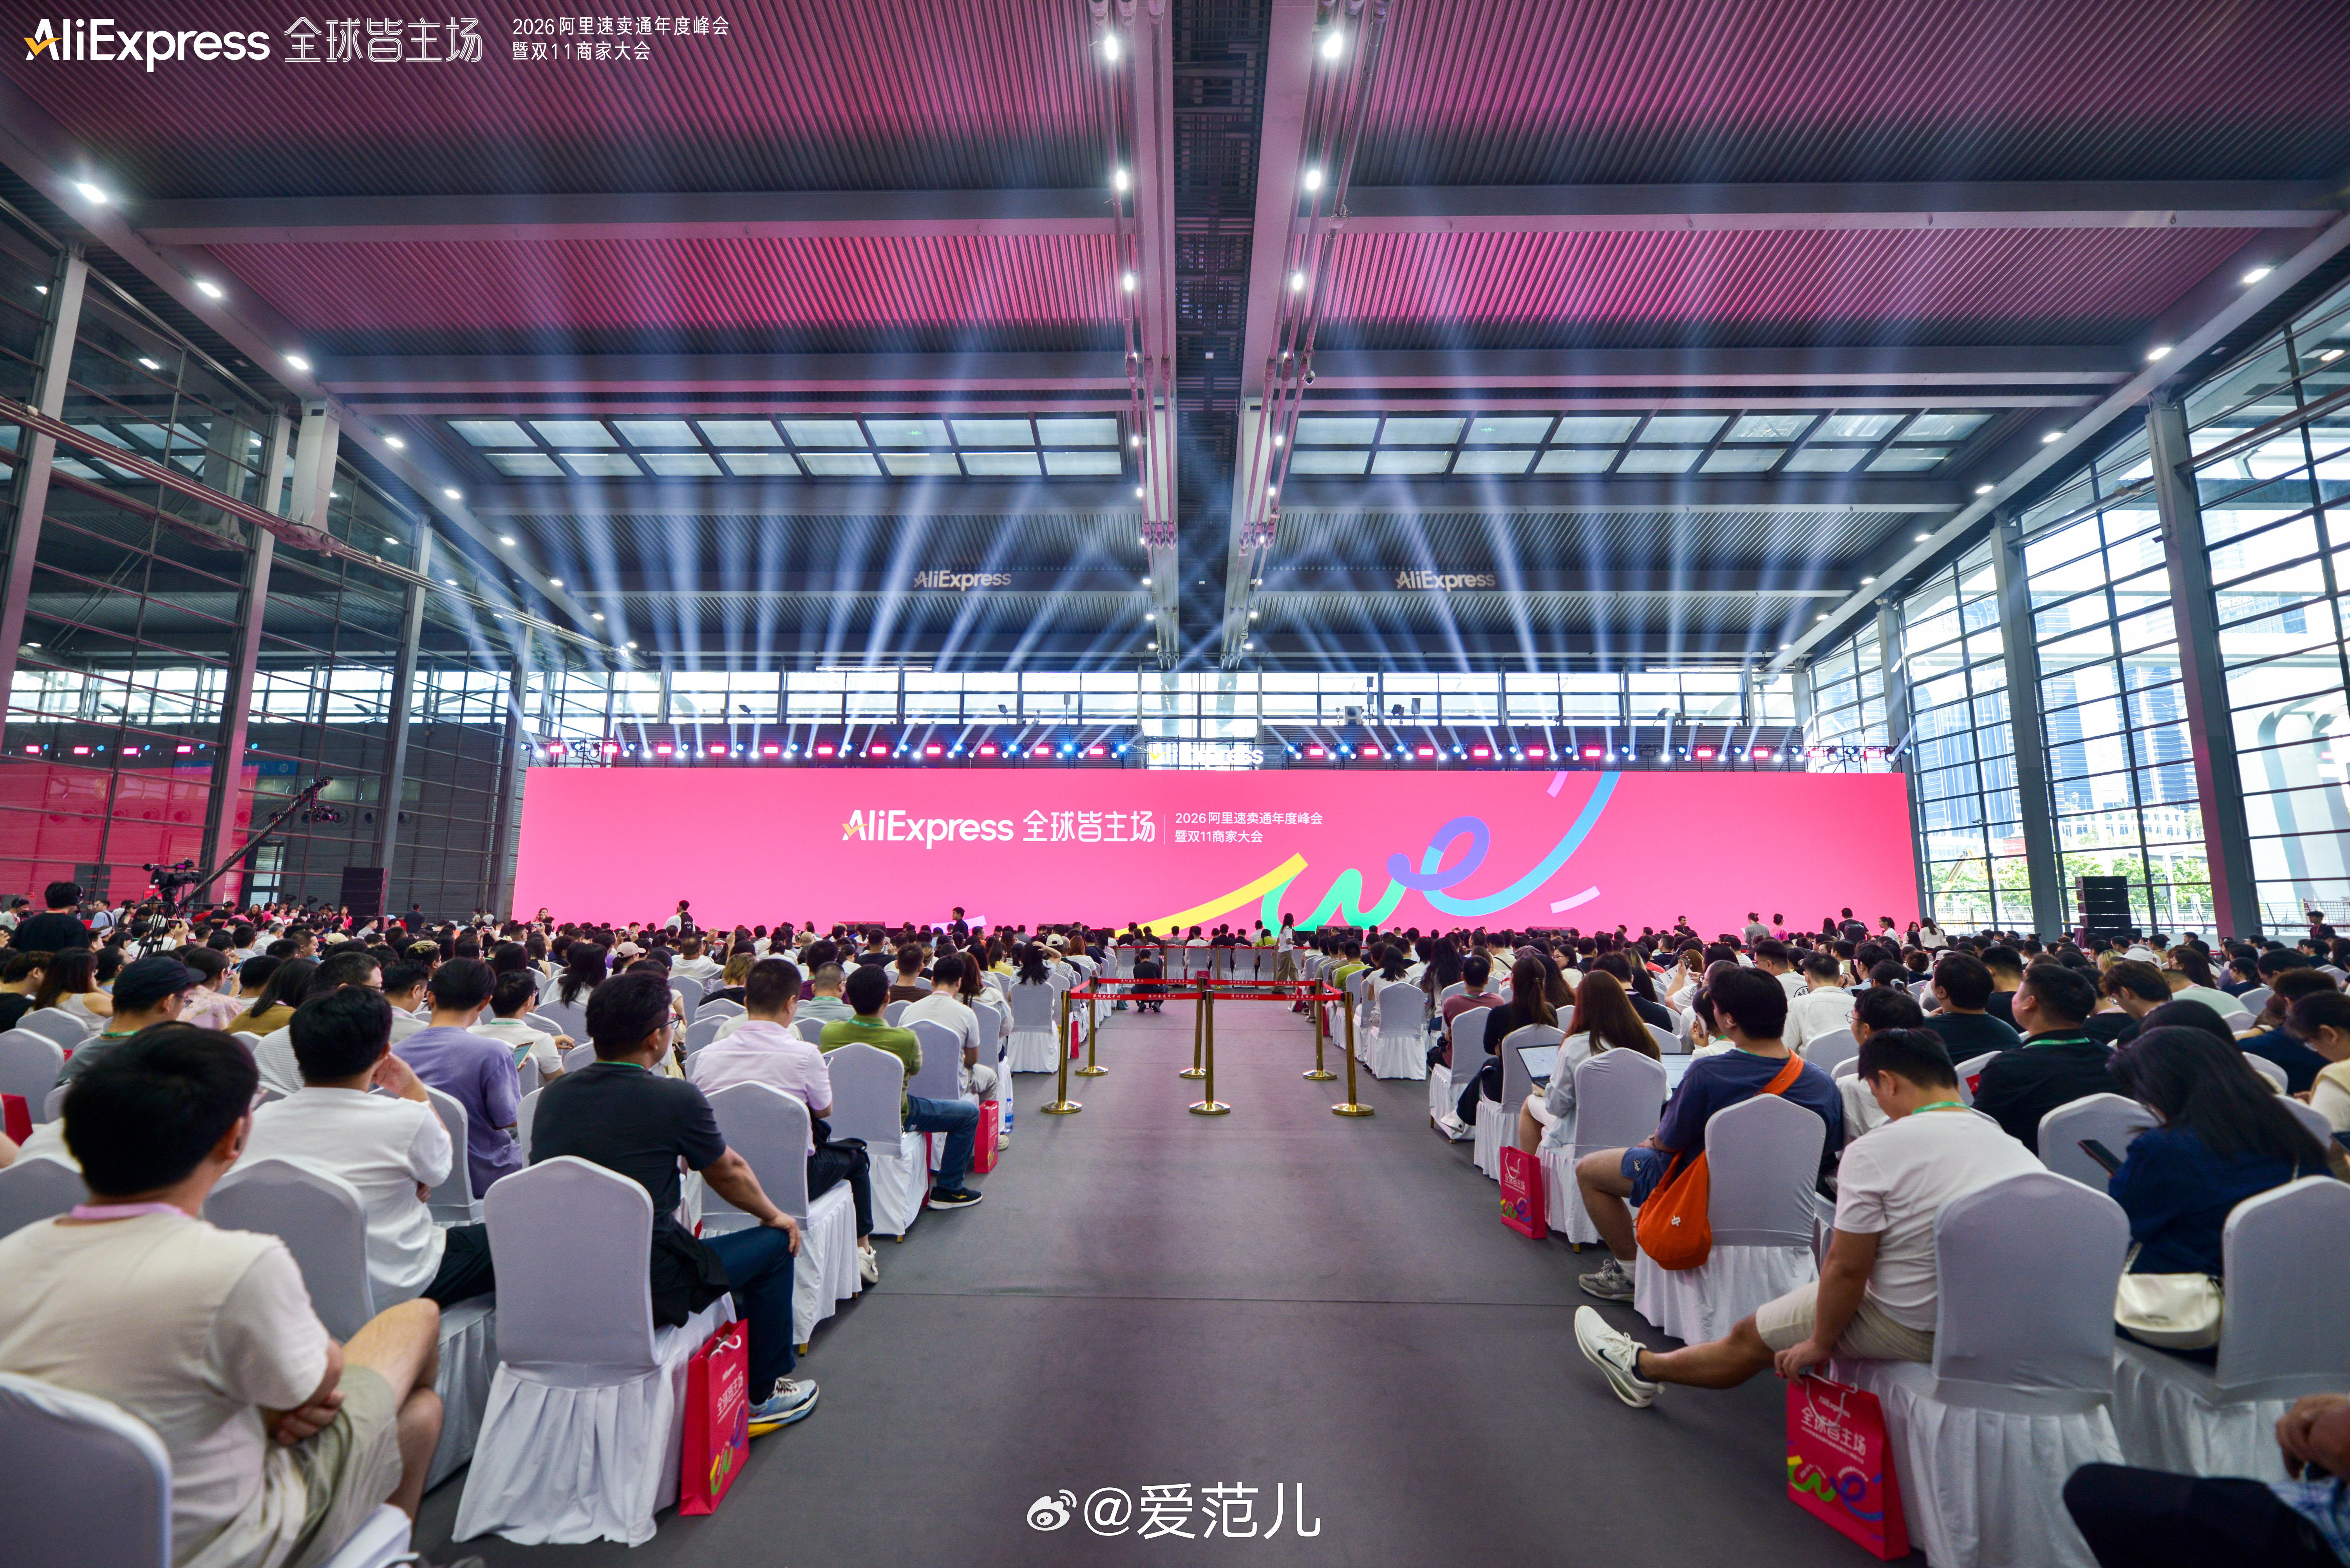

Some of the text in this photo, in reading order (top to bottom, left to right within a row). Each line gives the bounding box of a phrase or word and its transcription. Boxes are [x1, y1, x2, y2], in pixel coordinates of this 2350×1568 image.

[914, 570, 1011, 591] AliExpress
[1396, 571, 1495, 592] AliExpress
[1148, 743, 1264, 770] Alixpress
[842, 809, 1014, 849] AliExpress
[1023, 809, 1155, 842] 全球皆主场
[1175, 830, 1263, 843] 暨双11商家大会
[1818, 1395, 1851, 1418] AliExpss
